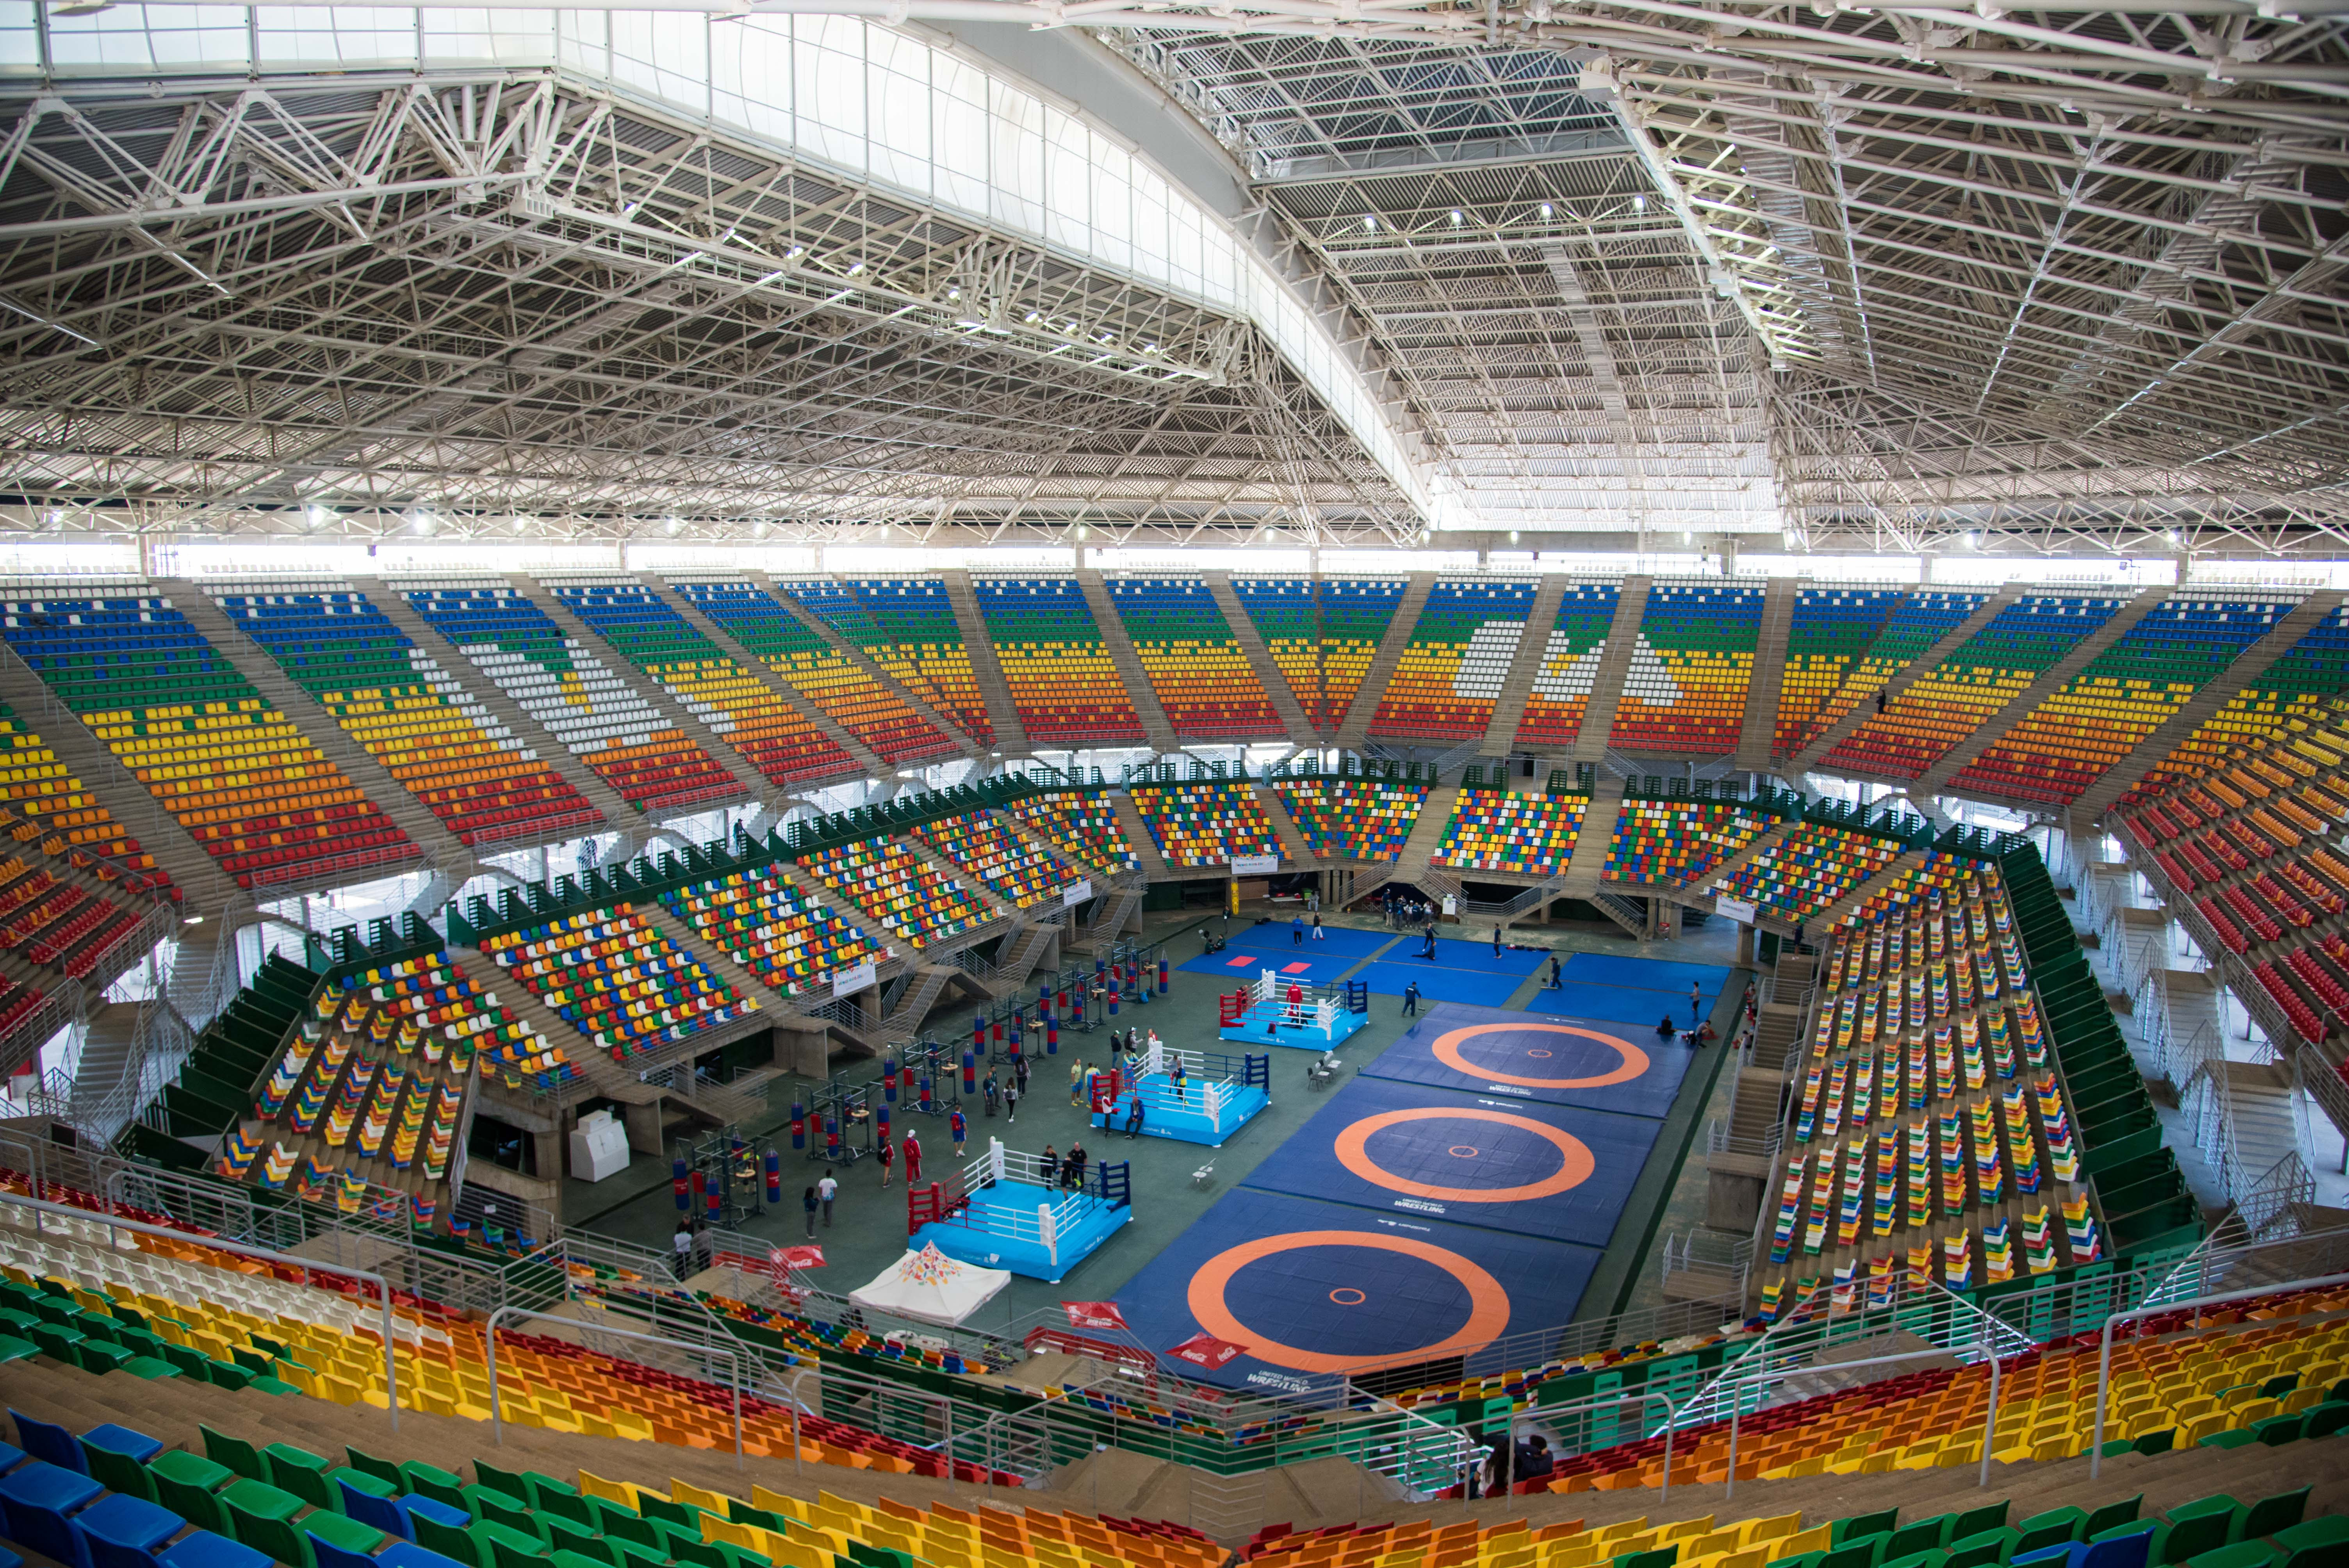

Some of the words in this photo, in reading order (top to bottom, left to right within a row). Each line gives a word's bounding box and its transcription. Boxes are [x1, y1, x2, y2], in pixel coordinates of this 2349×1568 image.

[1489, 1085, 1532, 1096] WRESTLING
[1394, 1200, 1446, 1214] WRESTLING
[1258, 1370, 1283, 1379] UNITED
